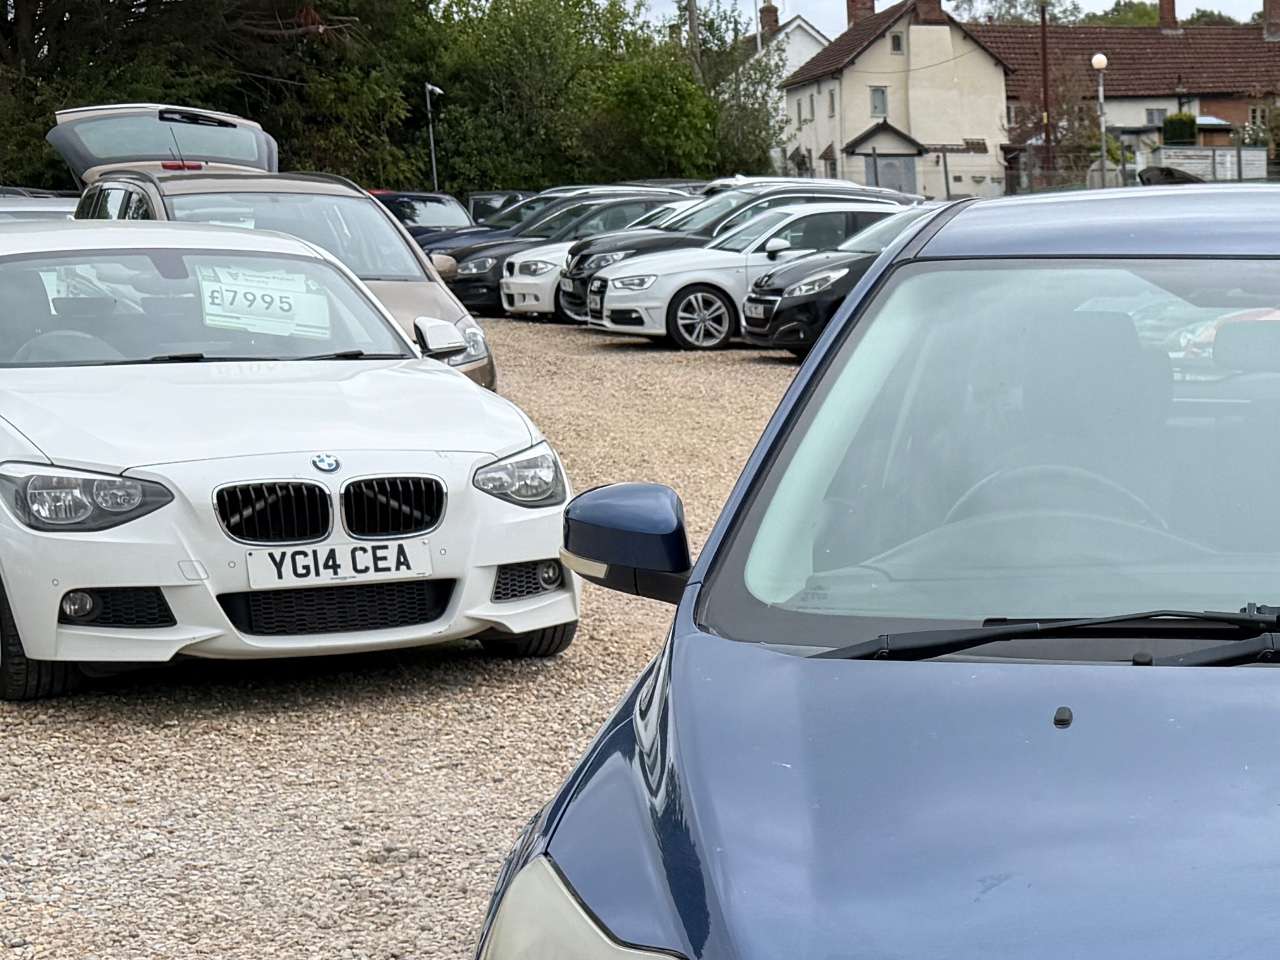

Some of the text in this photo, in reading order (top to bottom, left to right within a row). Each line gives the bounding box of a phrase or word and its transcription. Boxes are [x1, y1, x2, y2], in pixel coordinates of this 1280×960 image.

[209, 289, 293, 313] £7995
[268, 543, 412, 580] YG14 CEA
